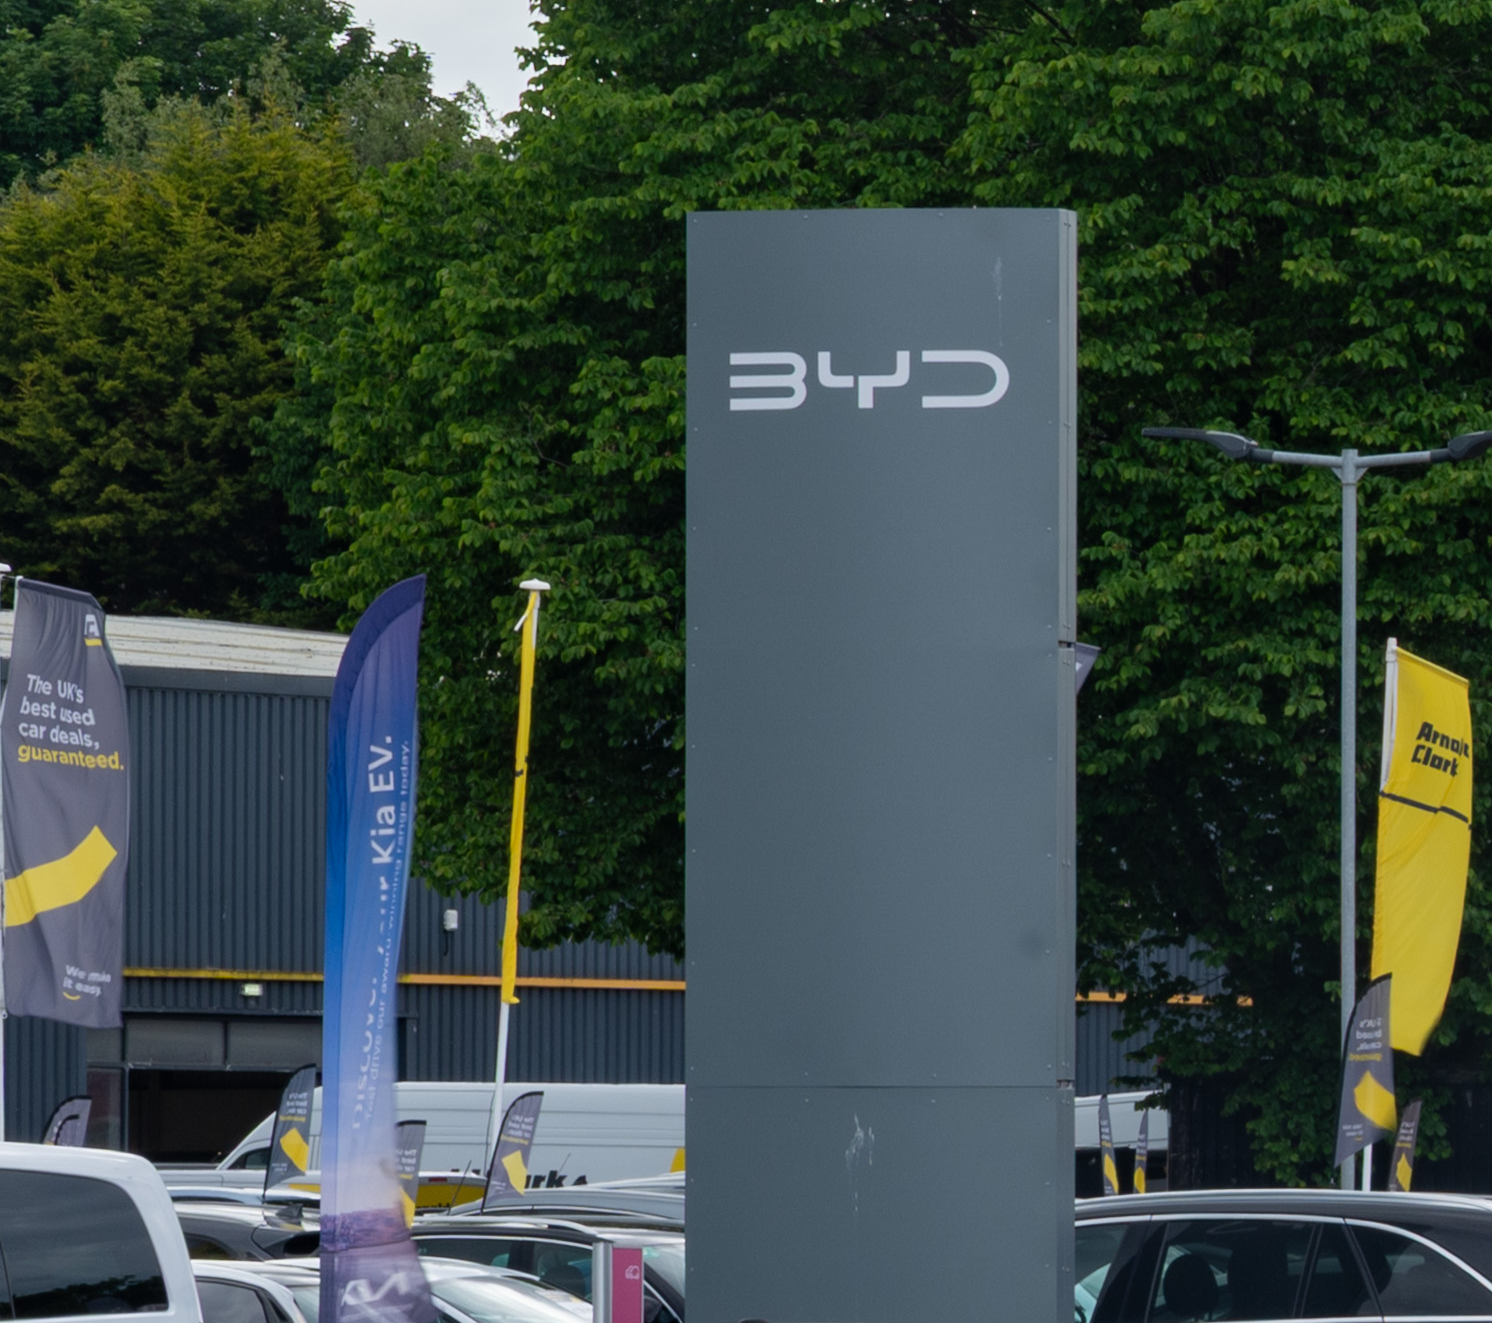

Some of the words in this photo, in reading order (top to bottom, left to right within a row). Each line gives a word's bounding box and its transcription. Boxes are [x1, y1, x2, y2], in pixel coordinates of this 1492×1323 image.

[730, 350, 1009, 411] BYD
[27, 674, 52, 695] The
[57, 679, 84, 704] UK's
[20, 696, 56, 719] best
[60, 708, 95, 726] used
[19, 722, 46, 739] car
[50, 725, 100, 750] deals,
[18, 744, 124, 770] guaranteed.
[368, 736, 394, 793] EV.
[370, 805, 396, 864] Kia
